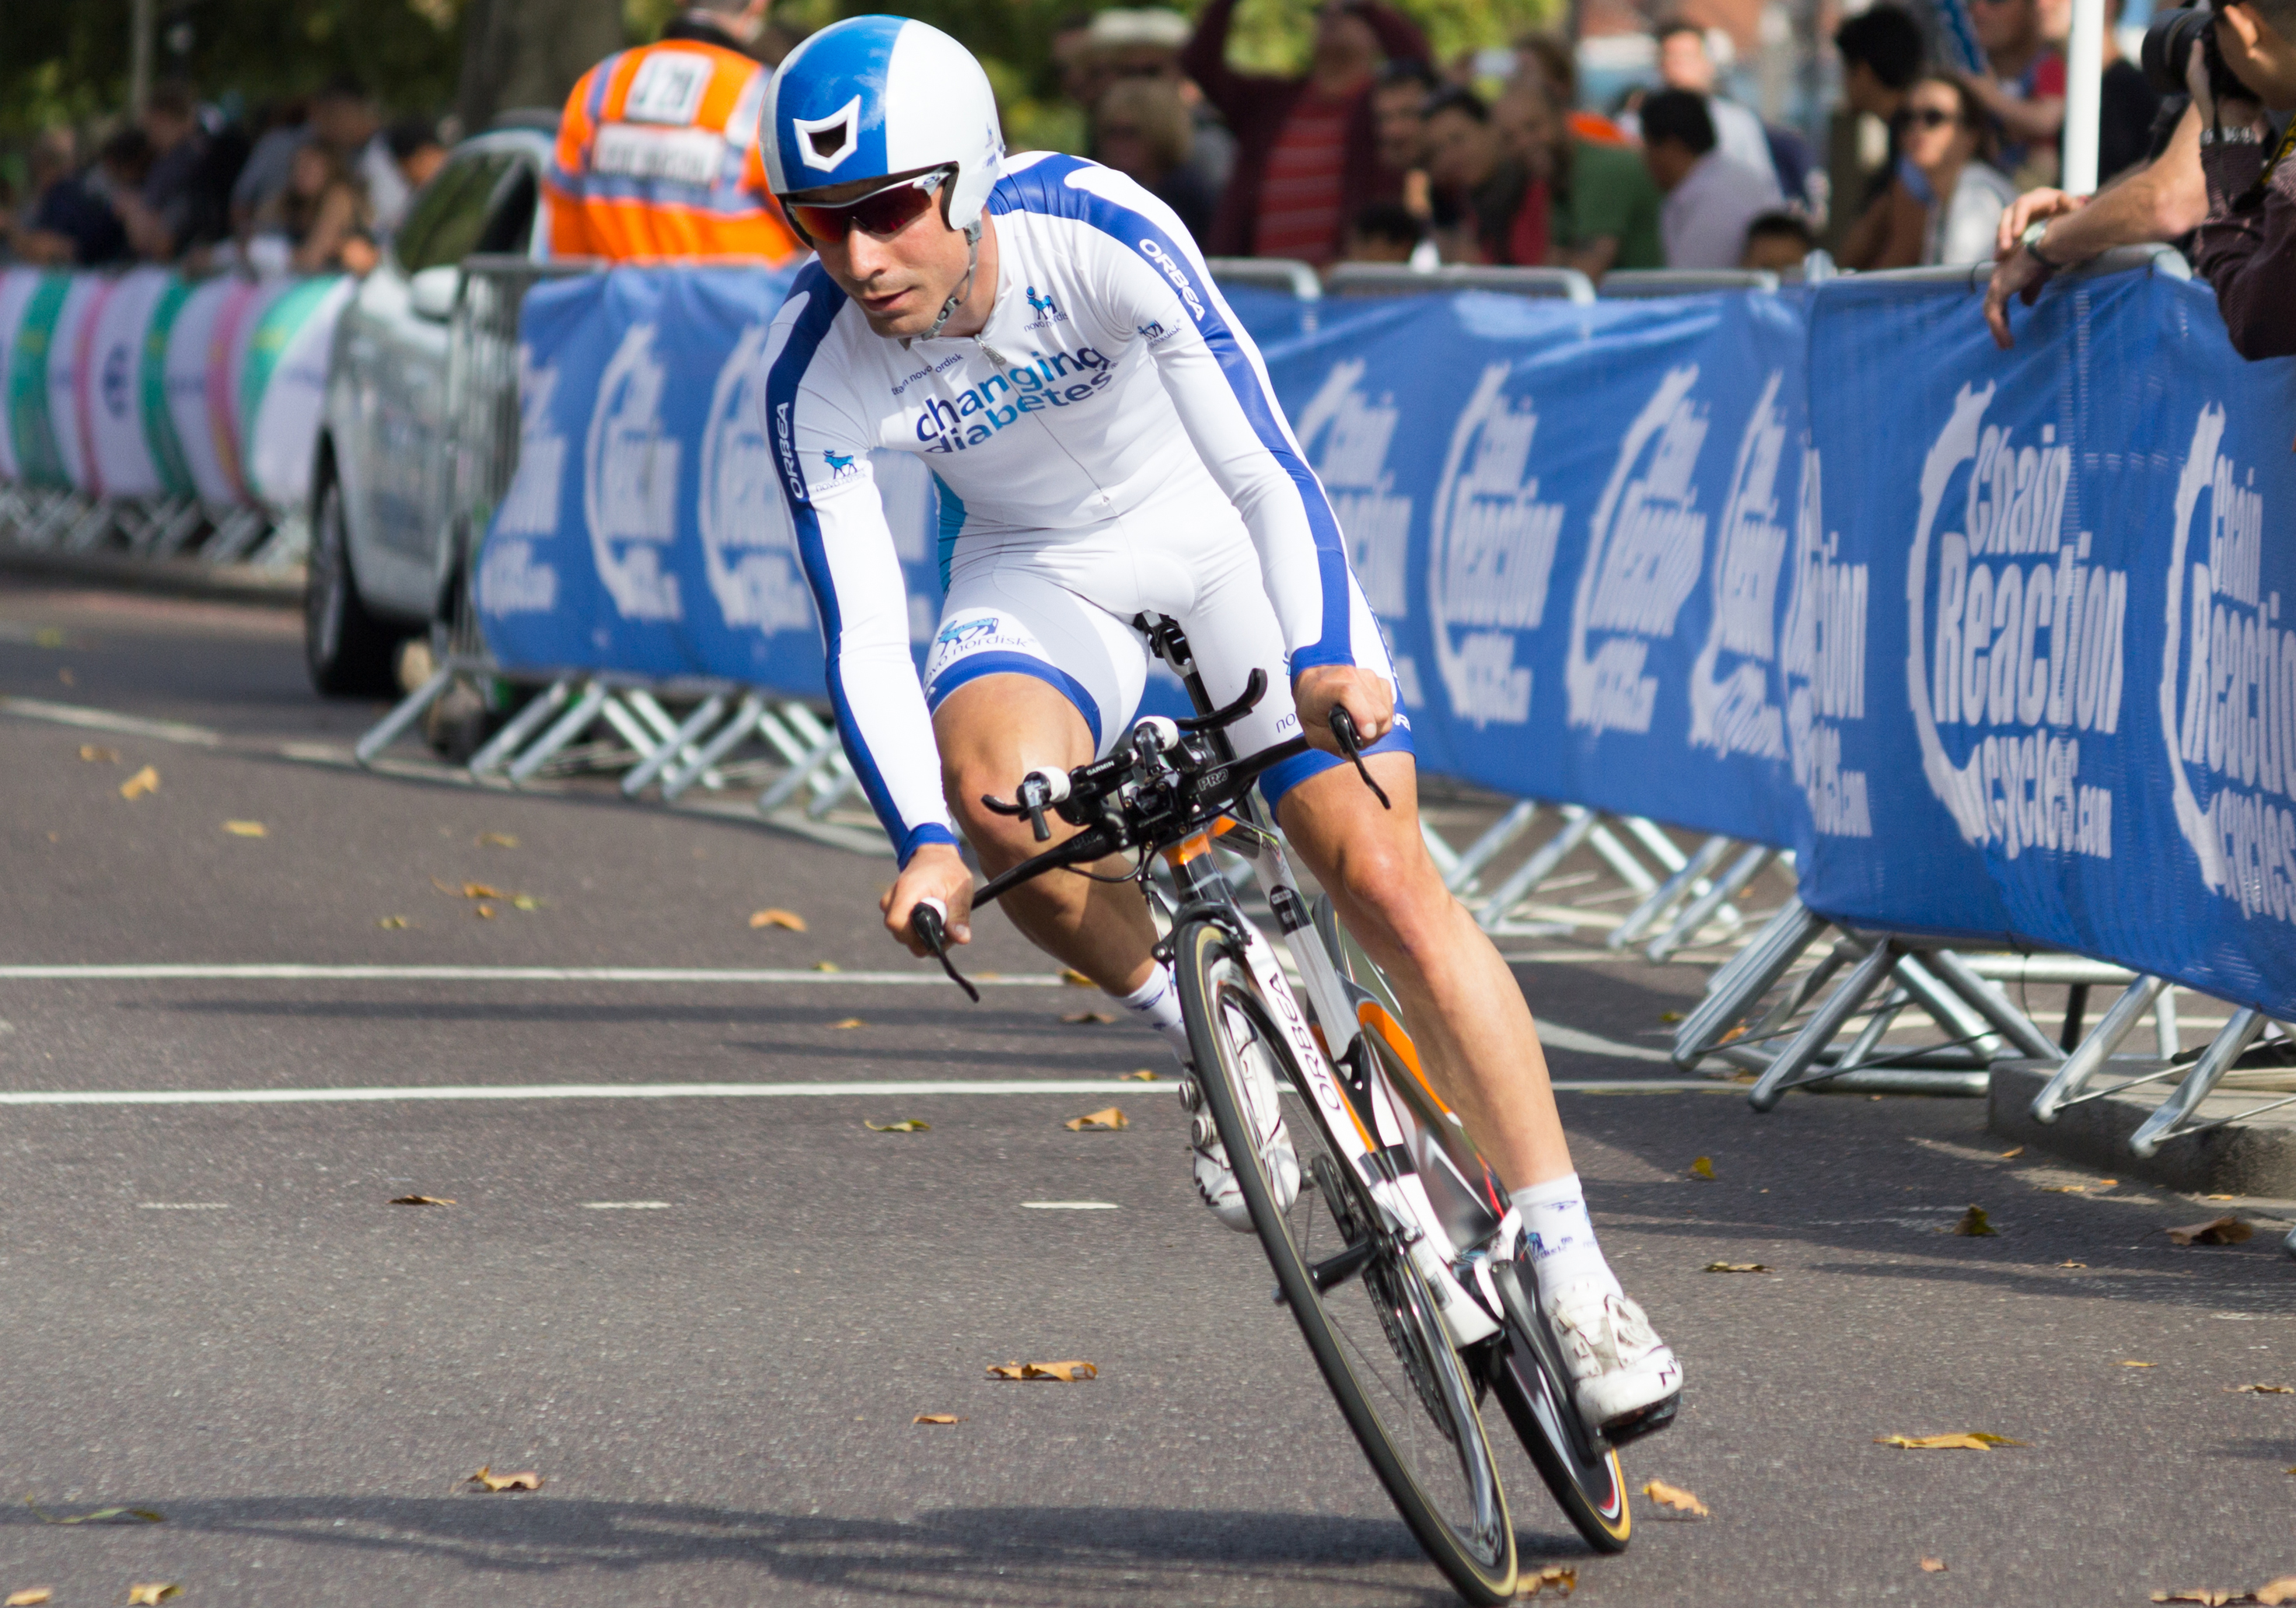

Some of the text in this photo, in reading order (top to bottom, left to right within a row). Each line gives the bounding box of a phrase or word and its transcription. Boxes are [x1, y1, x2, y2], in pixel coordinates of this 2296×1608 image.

[1139, 238, 1205, 322] ORBEA
[910, 365, 933, 382] novo
[935, 353, 963, 373] ordisk
[916, 347, 1112, 442] changing
[924, 369, 1113, 454] diabetes
[777, 402, 804, 498] ORBEA
[1966, 424, 2071, 558] Chain
[953, 634, 1027, 656] nordisk
[1934, 530, 2127, 735] Reaction
[1276, 713, 1296, 733] no
[2181, 561, 2296, 803] Reactio
[1085, 760, 1115, 776] GARMIN
[1270, 972, 1340, 1111] ORBEA
